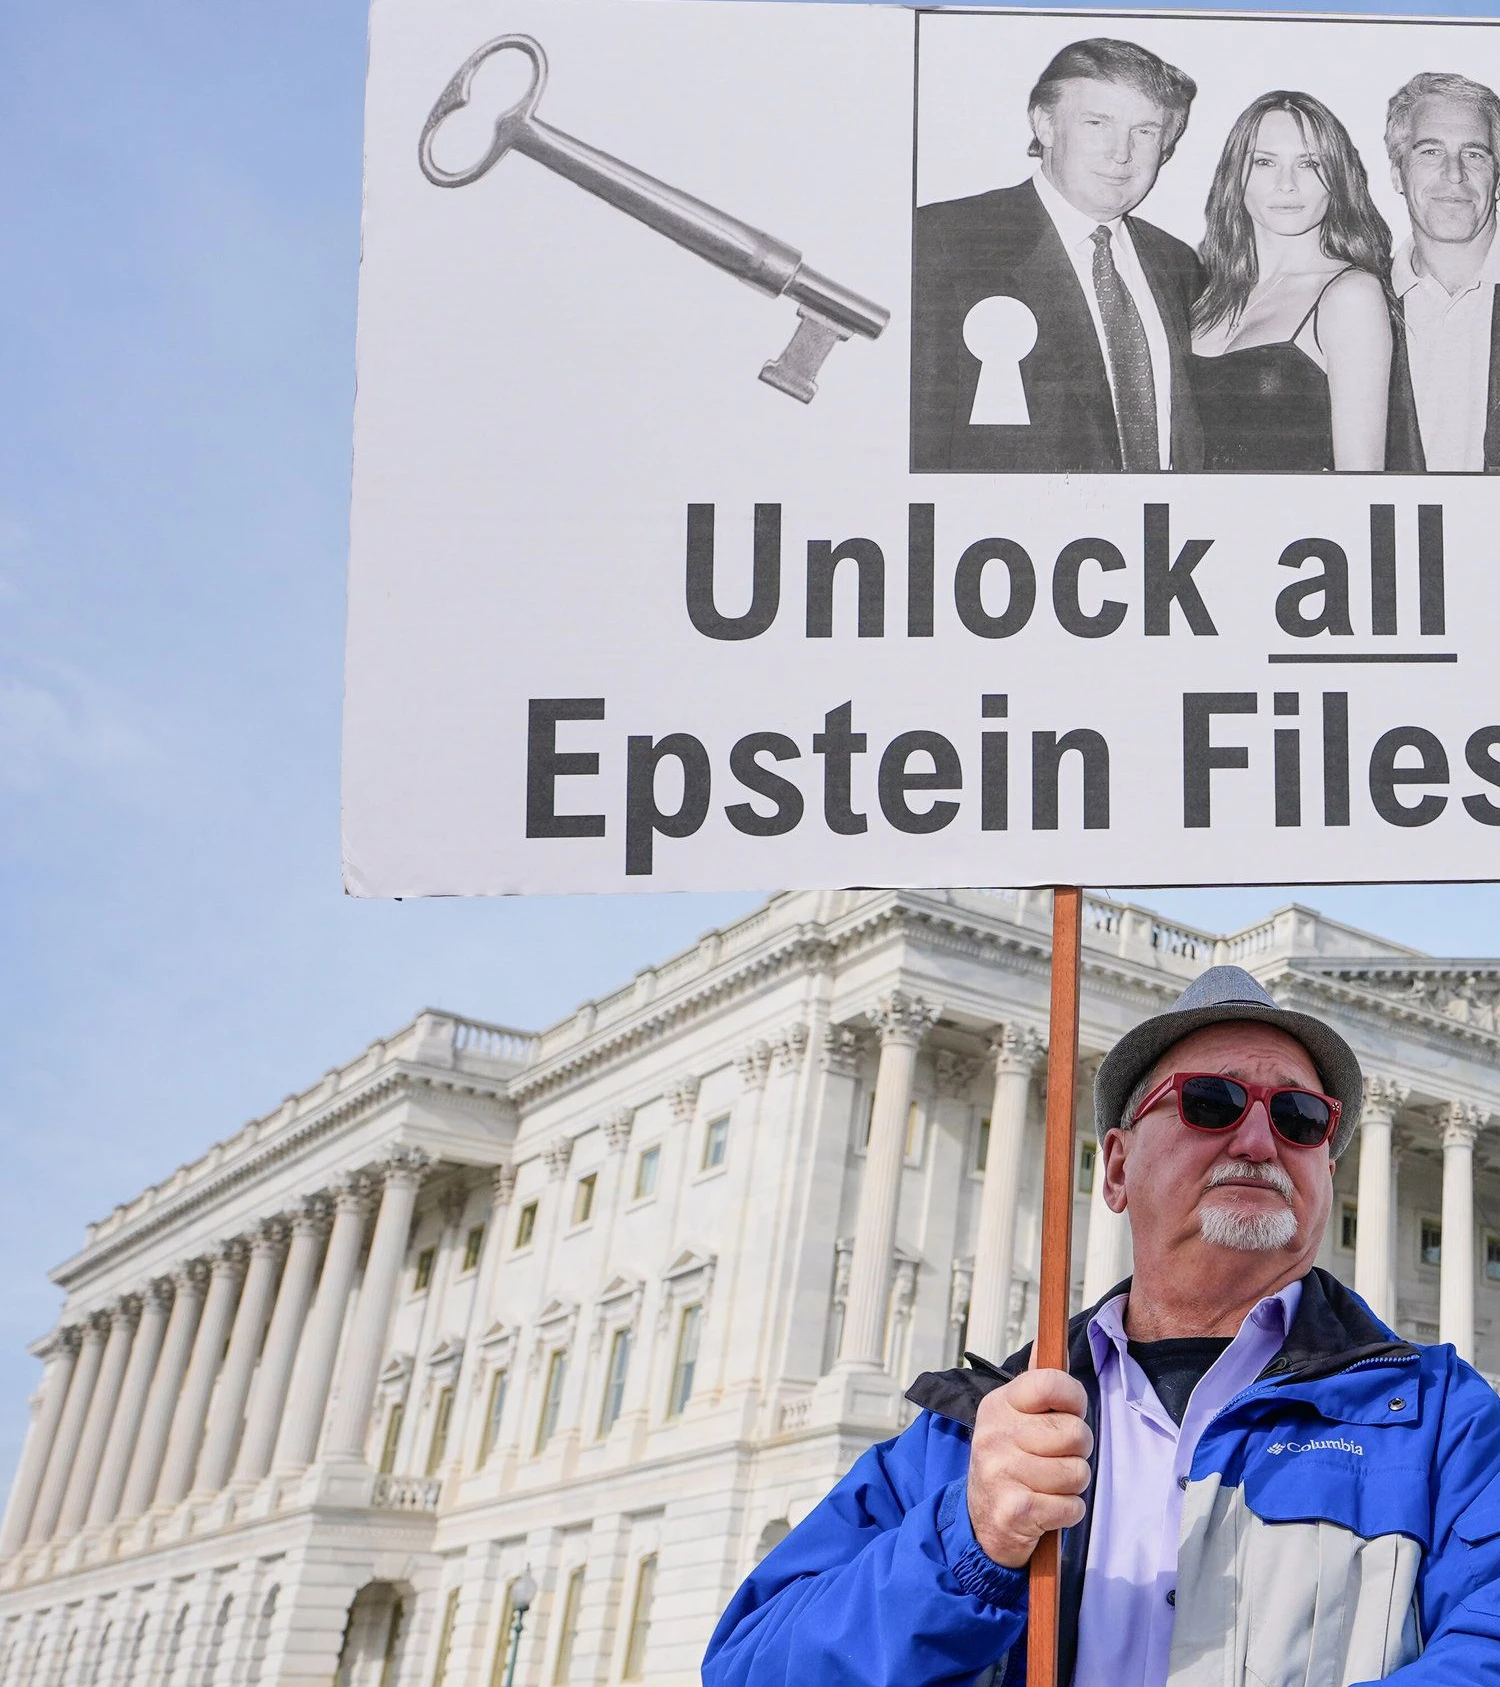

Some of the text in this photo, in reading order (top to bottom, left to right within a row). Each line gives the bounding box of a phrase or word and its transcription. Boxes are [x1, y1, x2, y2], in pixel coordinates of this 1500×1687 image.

[686, 502, 1447, 641] Unlock all
[525, 693, 1110, 876] Epstein
[1286, 1438, 1364, 1456] Columbia
